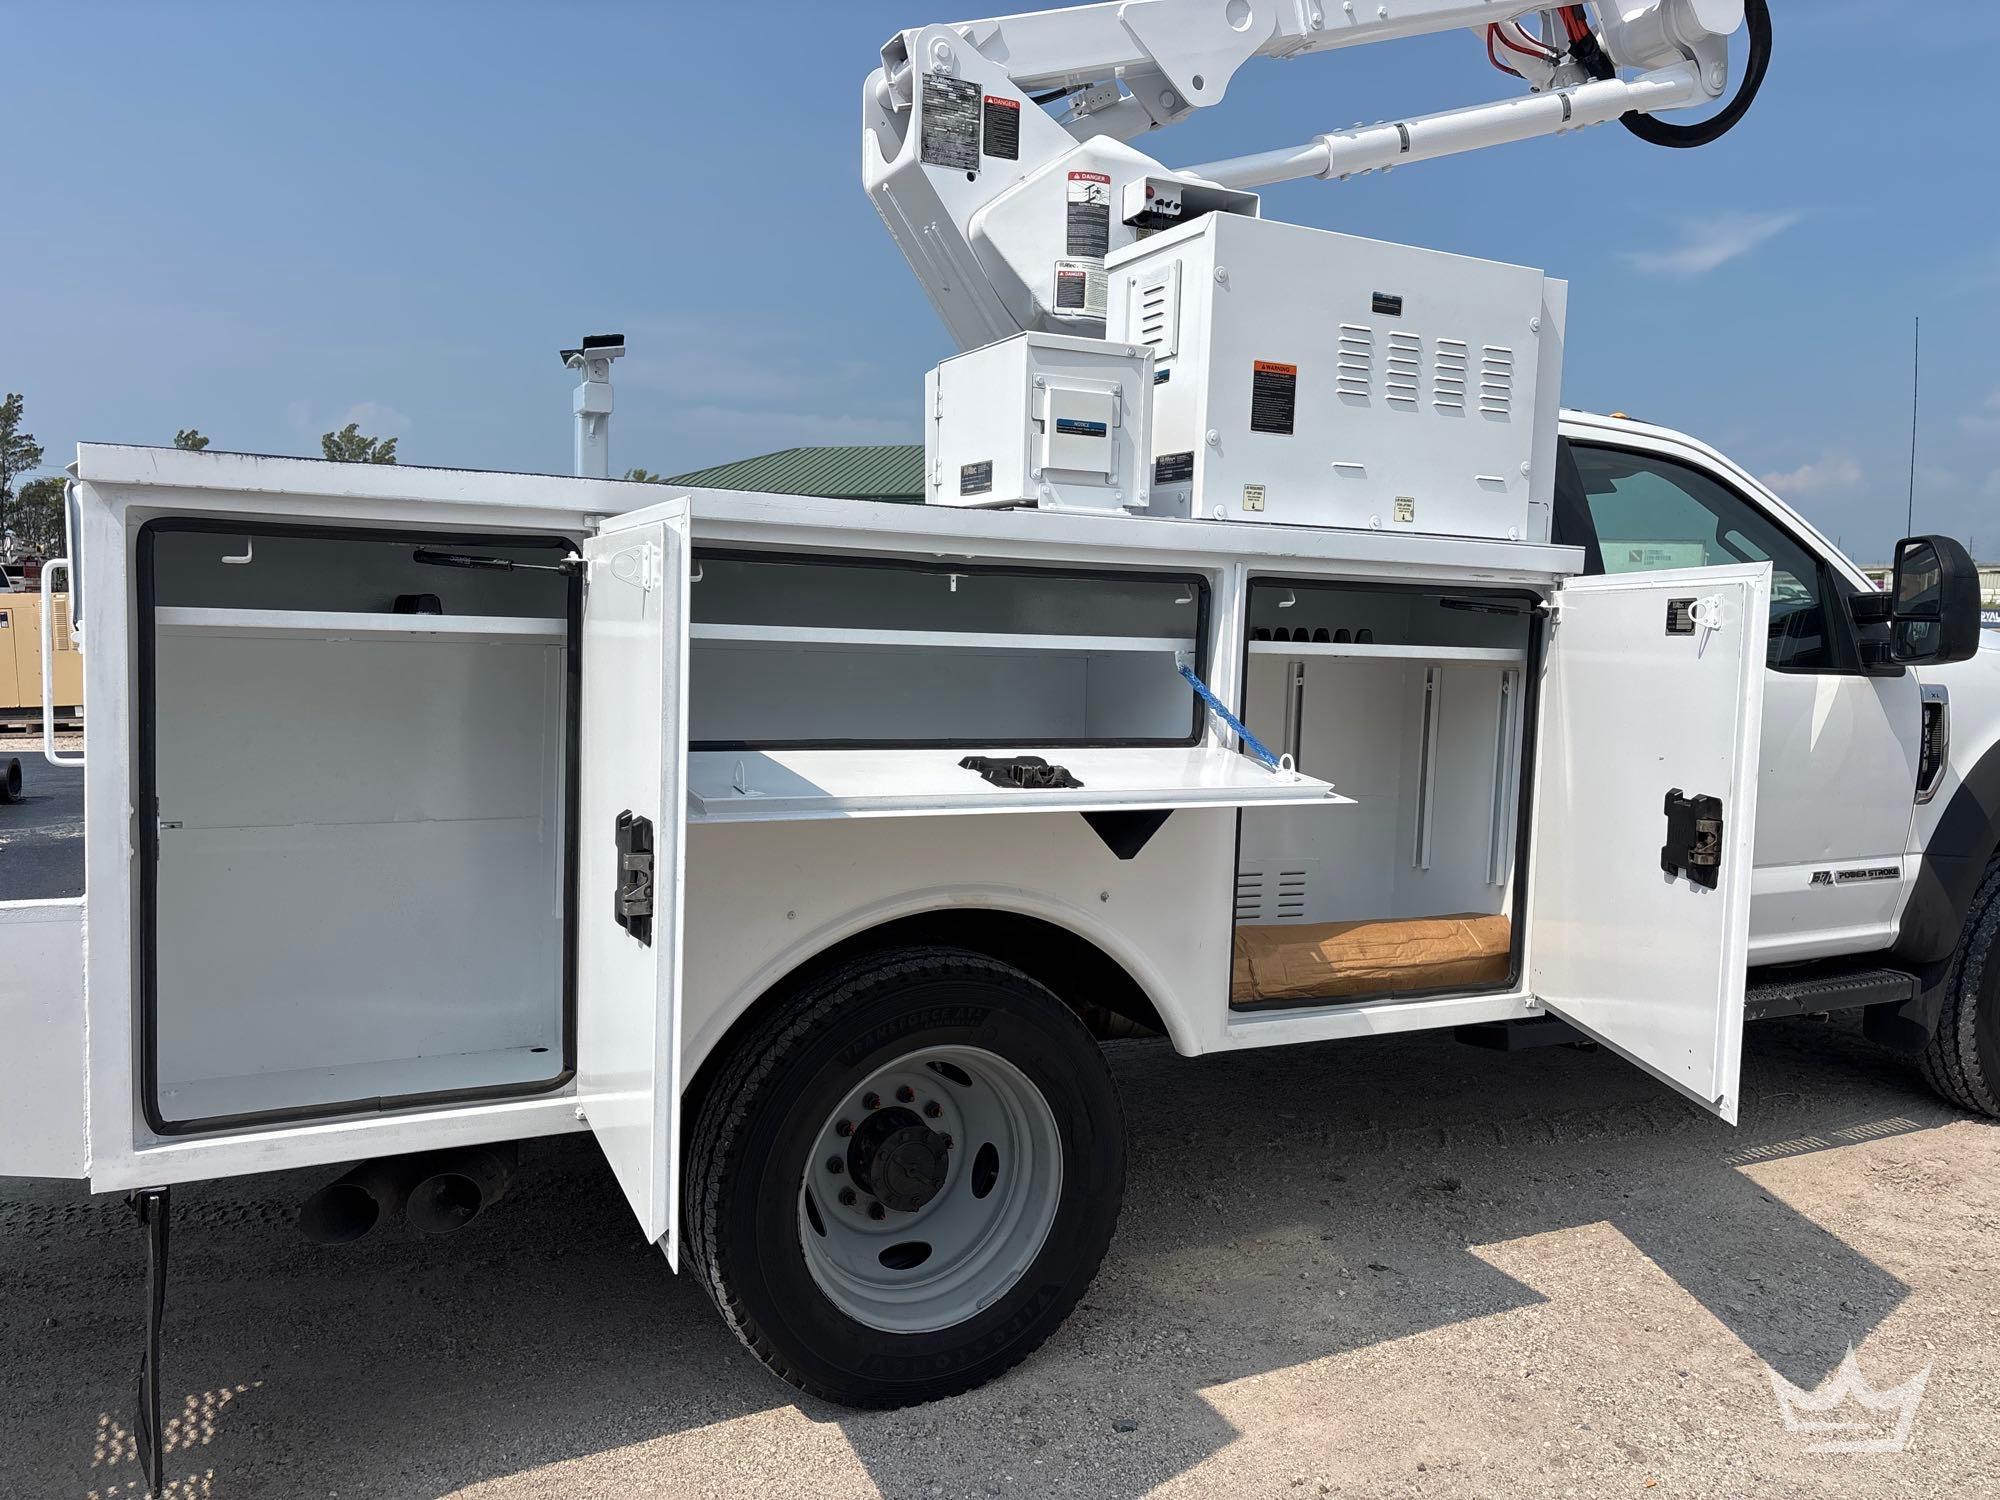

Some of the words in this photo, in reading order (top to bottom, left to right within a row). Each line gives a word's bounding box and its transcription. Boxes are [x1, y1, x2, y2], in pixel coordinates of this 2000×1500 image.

[993, 98, 1017, 107] DANGER
[1081, 173, 1106, 181] DANGER
[1266, 364, 1290, 373] WARNING
[1868, 868, 1900, 877] STROKE
